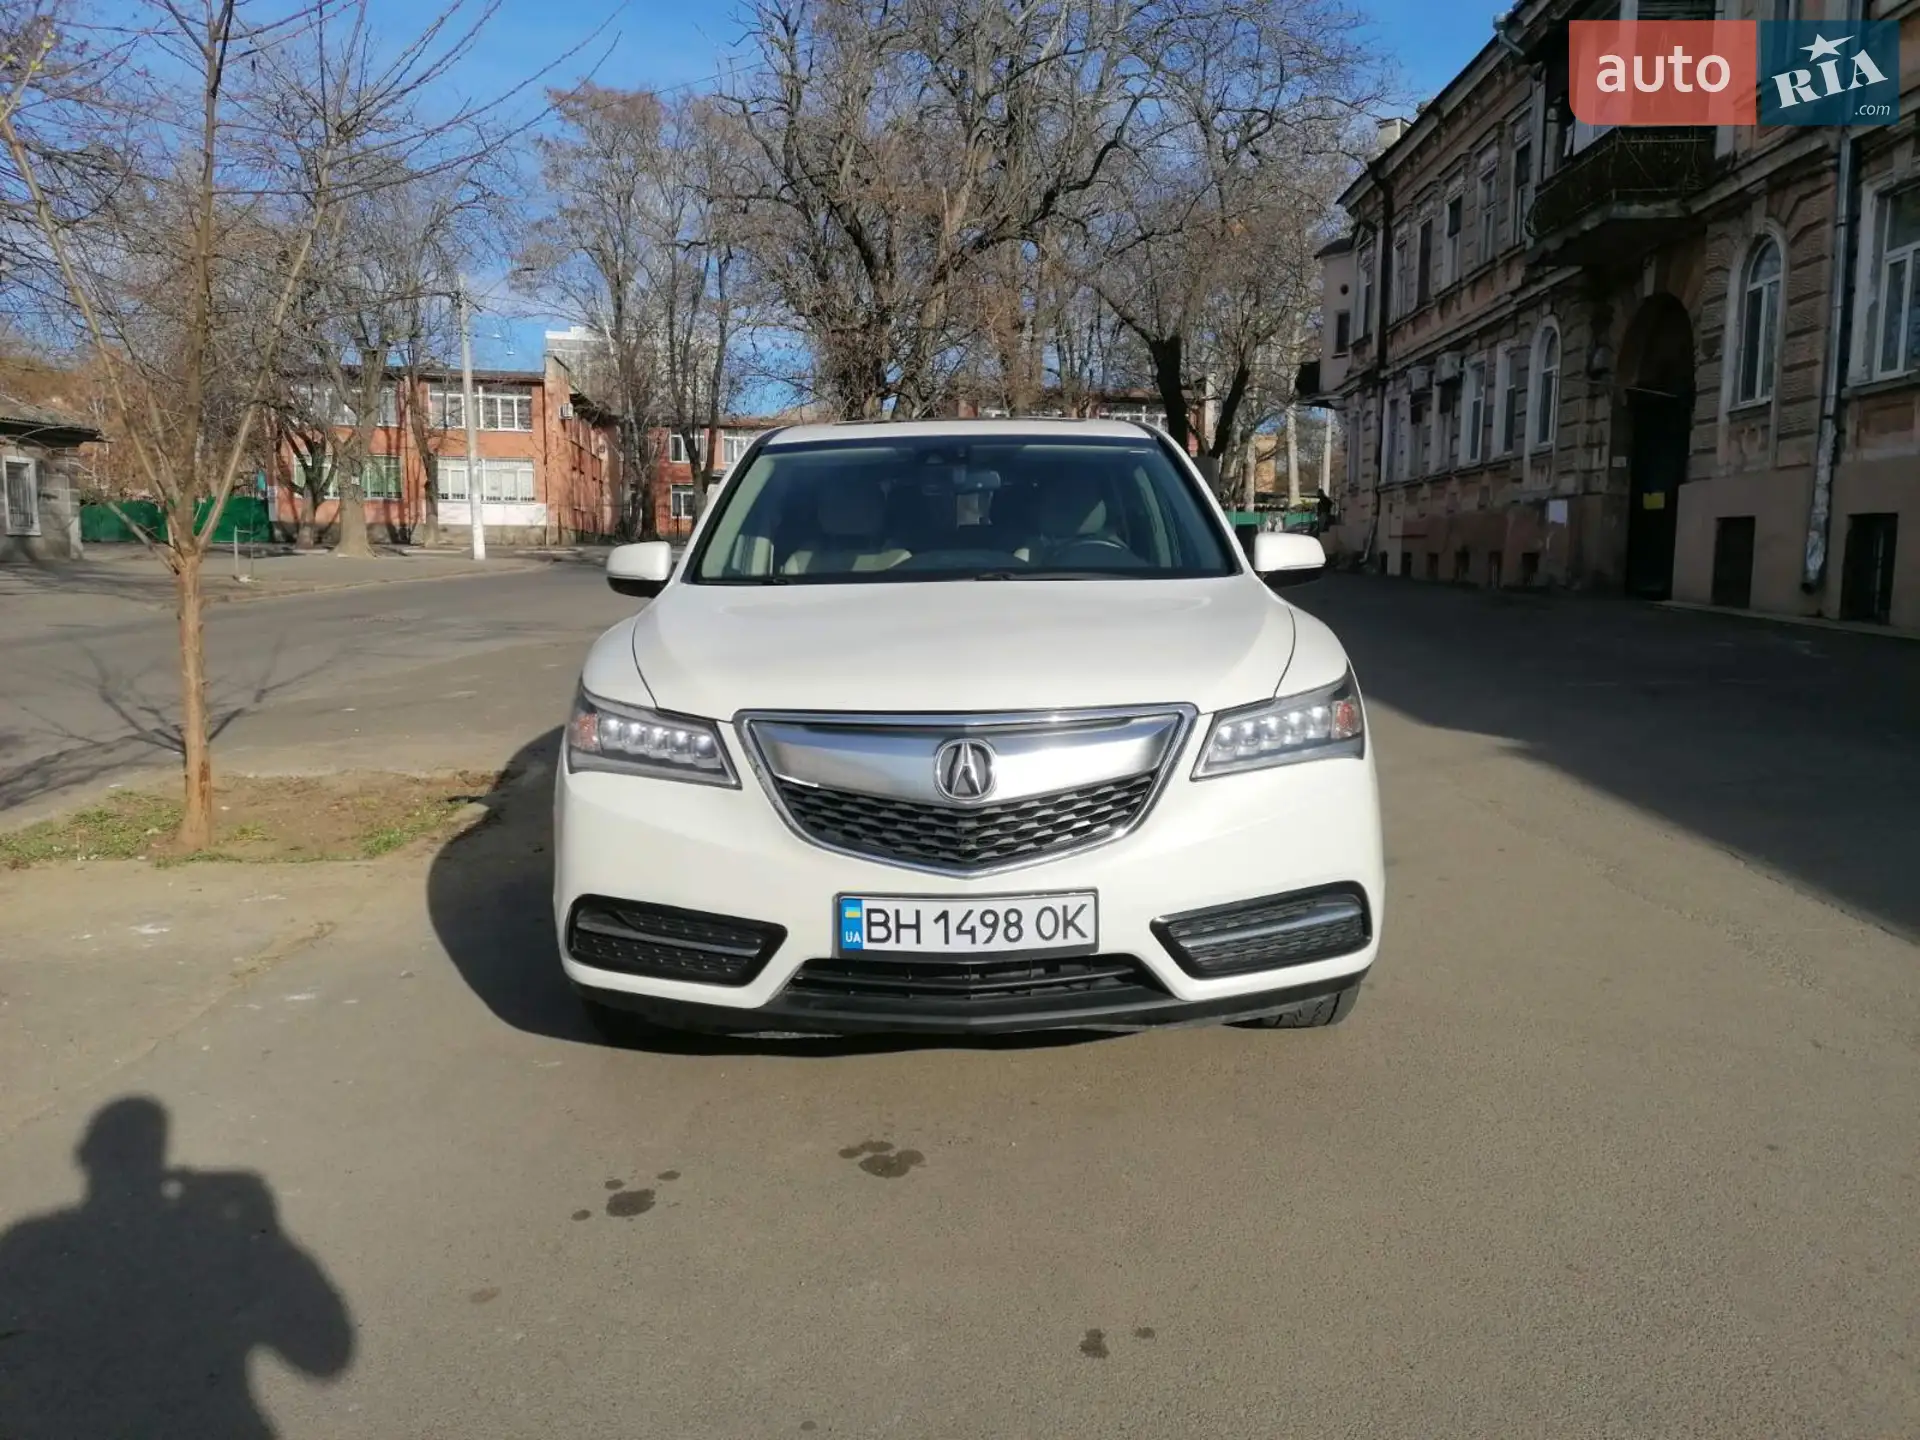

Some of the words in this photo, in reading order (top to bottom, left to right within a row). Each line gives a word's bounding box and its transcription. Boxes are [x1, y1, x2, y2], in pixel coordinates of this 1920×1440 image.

[845, 931, 862, 943] UA
[866, 908, 921, 944] BH
[933, 908, 1023, 945] 1498
[1035, 903, 1088, 941] OK
